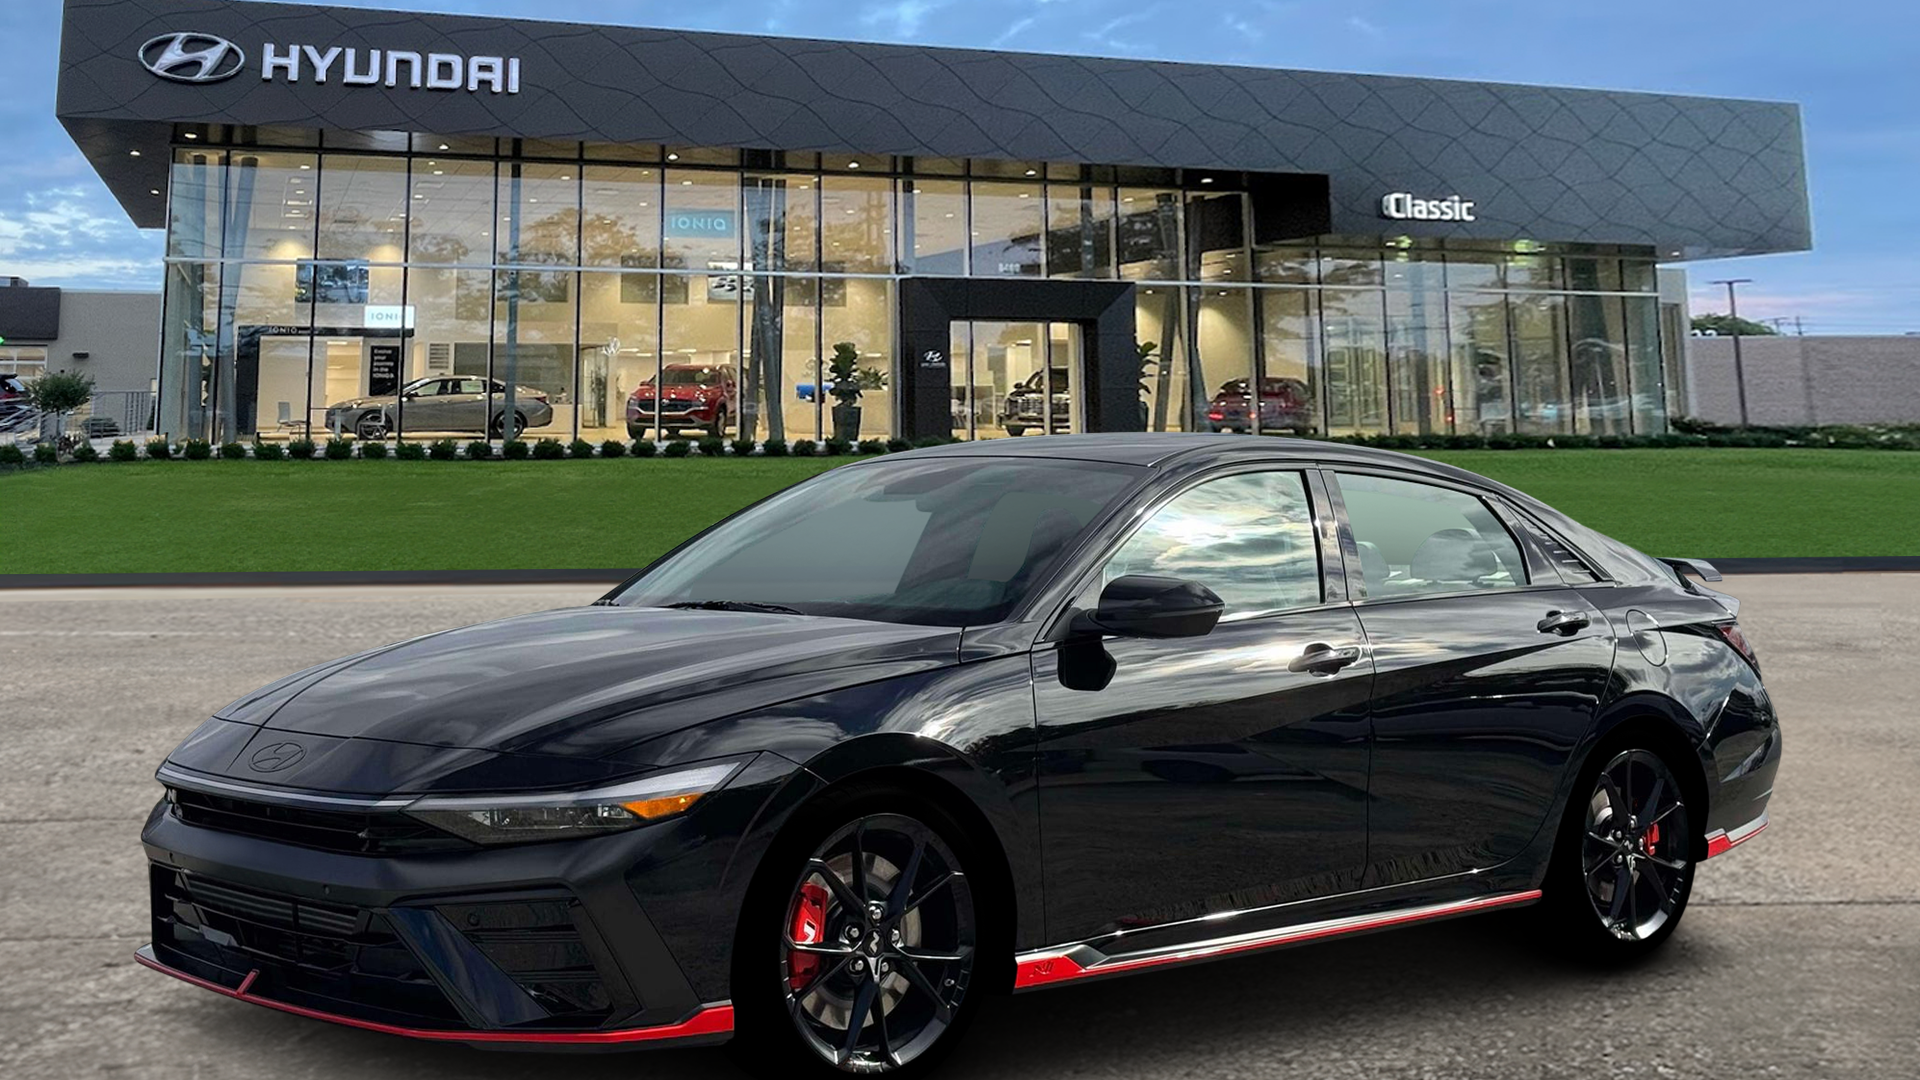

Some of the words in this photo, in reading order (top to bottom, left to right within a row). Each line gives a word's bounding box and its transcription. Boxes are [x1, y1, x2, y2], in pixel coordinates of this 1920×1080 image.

[261, 43, 520, 93] HYUNDAI
[1382, 193, 1476, 221] Classic
[670, 217, 726, 230] IONIQ
[370, 312, 402, 320] IONI
